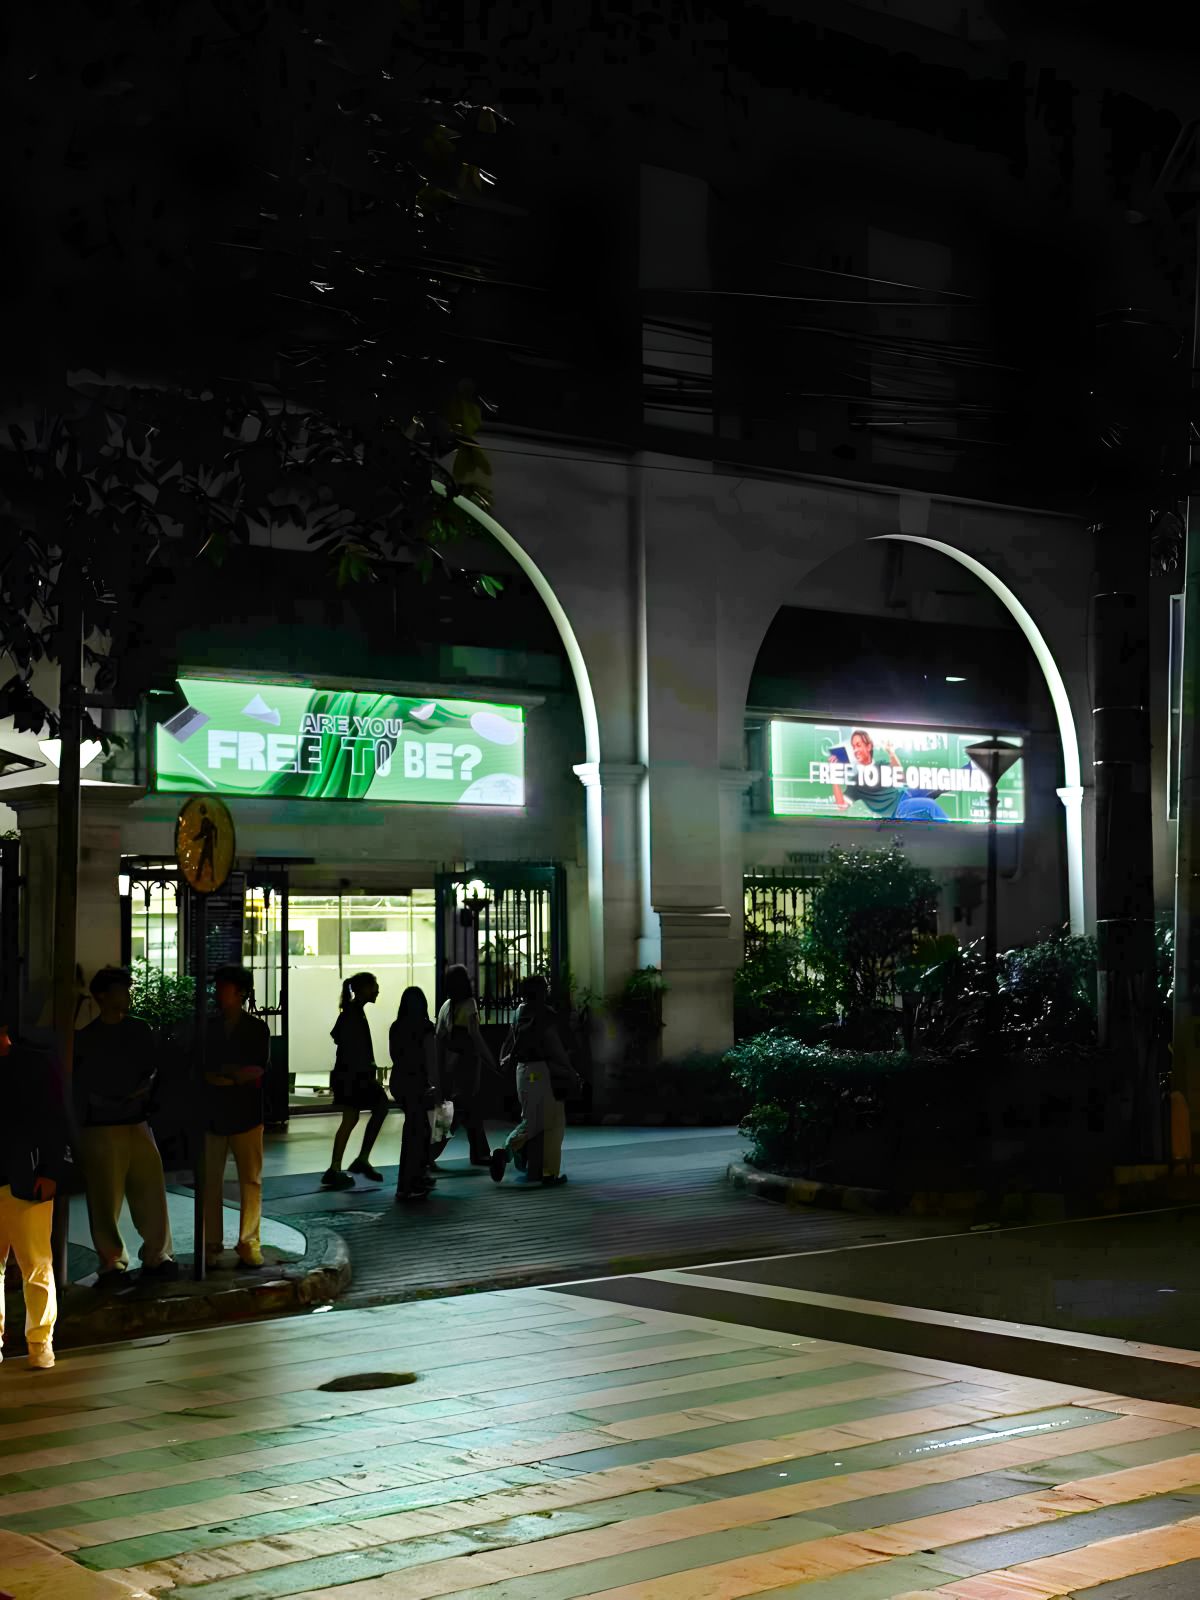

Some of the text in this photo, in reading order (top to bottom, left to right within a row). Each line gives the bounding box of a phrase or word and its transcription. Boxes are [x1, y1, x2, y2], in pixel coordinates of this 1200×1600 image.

[303, 713, 403, 738] ARE YOU
[207, 729, 483, 781] FREE TO BE?
[809, 761, 856, 786] FREE
[857, 765, 880, 787] TO
[880, 766, 905, 789] BE
